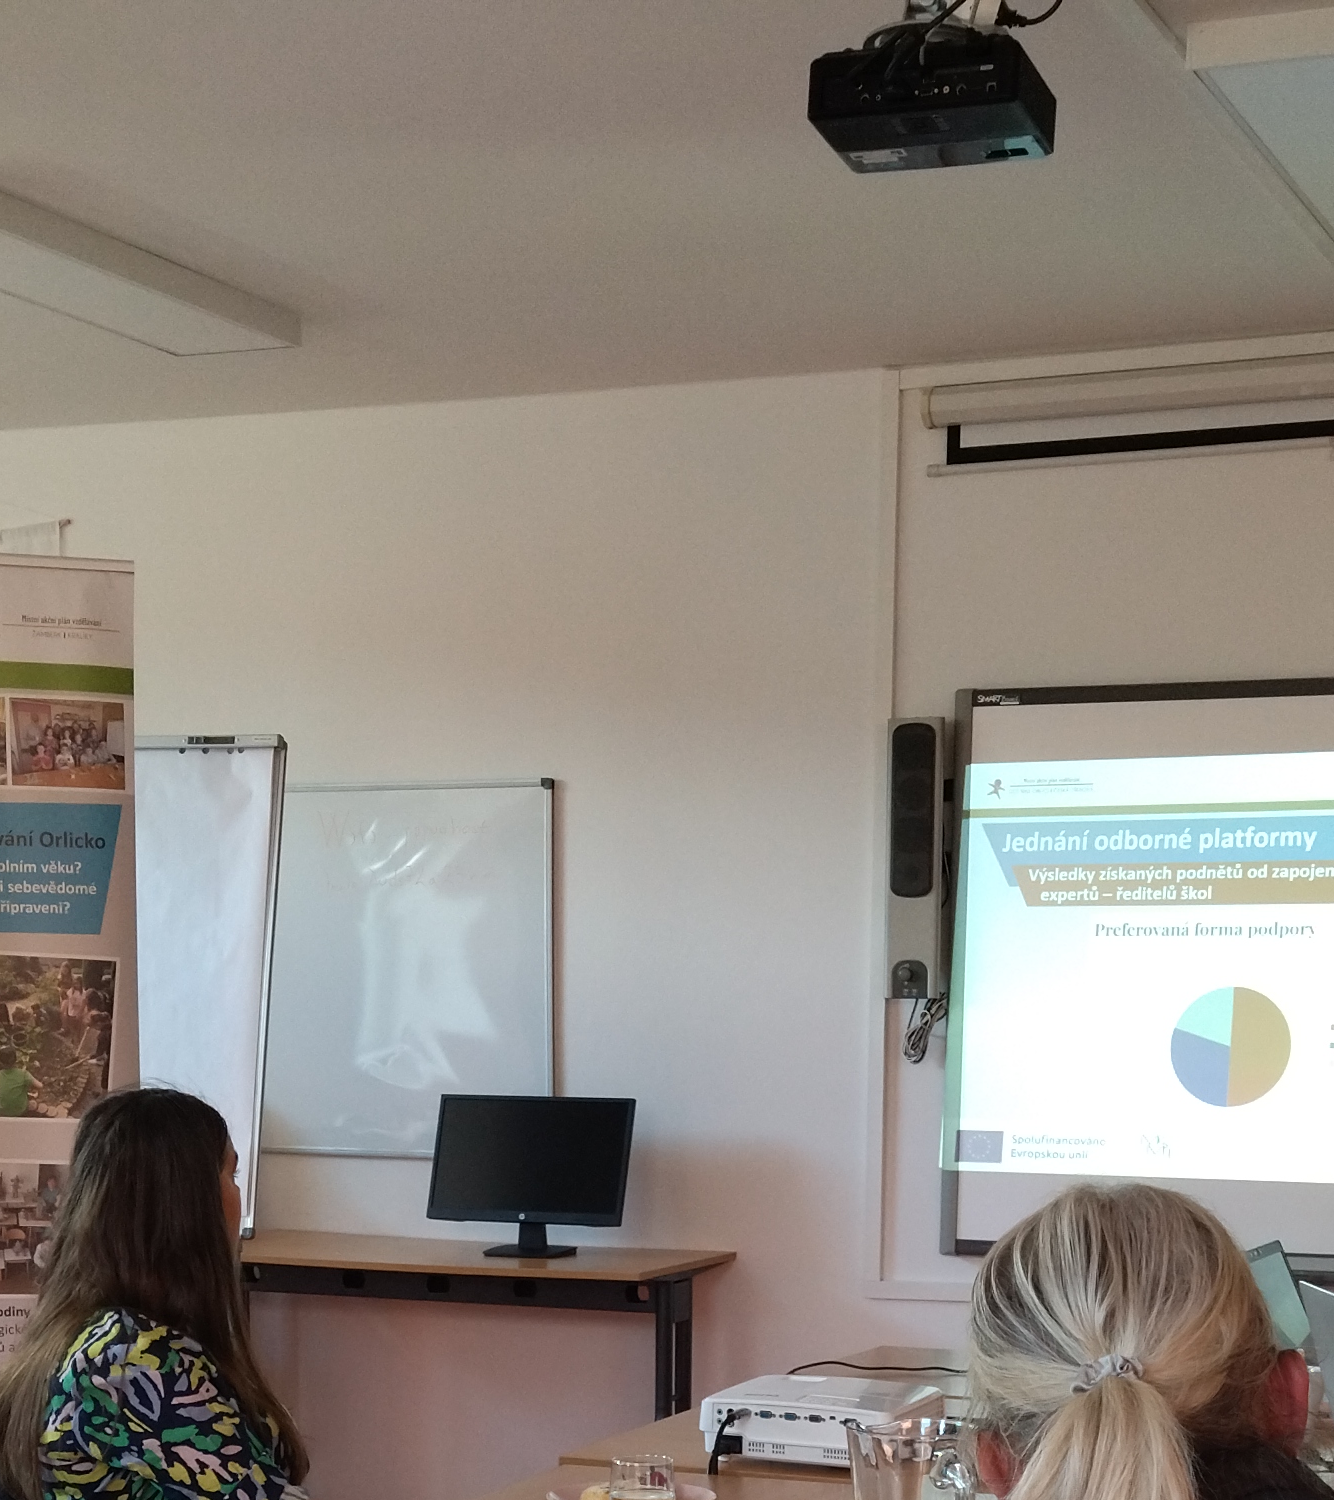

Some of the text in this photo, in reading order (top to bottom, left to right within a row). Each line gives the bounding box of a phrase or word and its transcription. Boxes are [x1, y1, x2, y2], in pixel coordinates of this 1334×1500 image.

[39, 831, 106, 849] Orlicko
[1002, 826, 1318, 853] Jednání odborné platformy
[41, 860, 82, 875] věku?
[1028, 866, 1096, 885] Výsledky
[1099, 865, 1172, 883] získaných
[1176, 863, 1244, 883] podnětů
[1247, 864, 1268, 880] od
[8, 881, 97, 895] sebevědomé
[1040, 887, 1099, 905] expertů
[1116, 885, 1177, 901] ředitelů
[1180, 885, 1212, 901] škol
[1095, 921, 1316, 939] Preferovaná forma podpory
[1010, 1148, 1066, 1161] Evropskou
